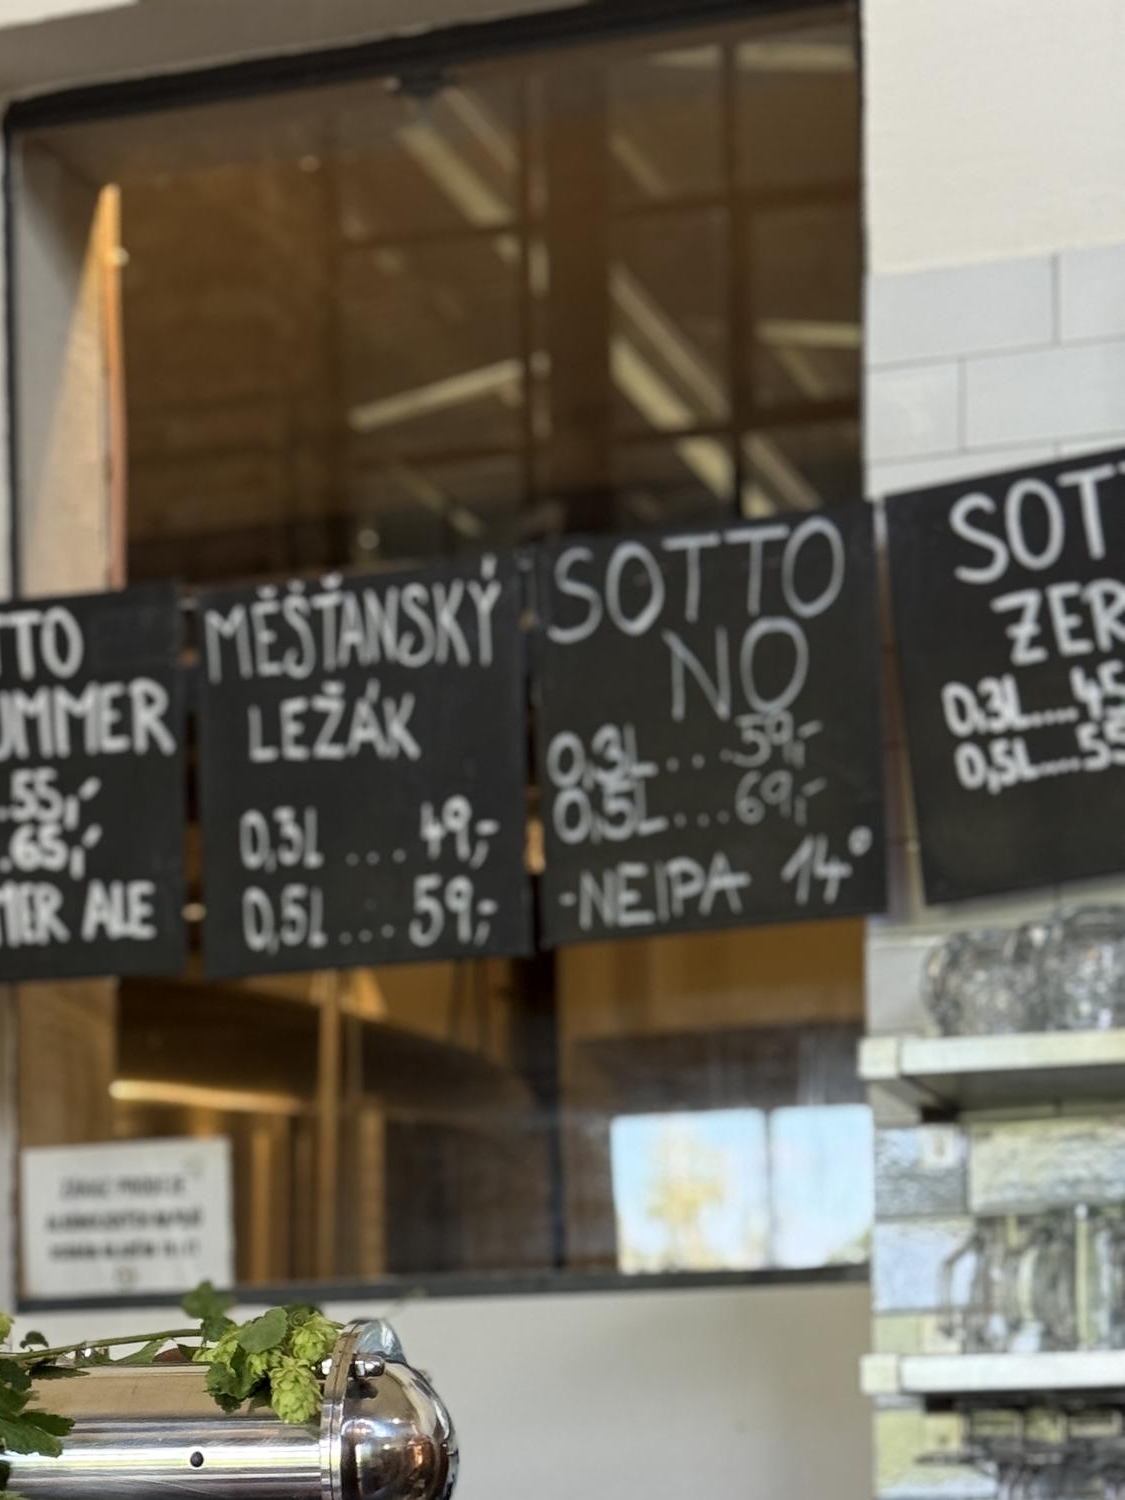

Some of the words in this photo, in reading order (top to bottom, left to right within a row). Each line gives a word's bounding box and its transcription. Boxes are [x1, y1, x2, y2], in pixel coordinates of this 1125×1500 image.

[949, 461, 1125, 584] SOT
[546, 515, 845, 644] SOTTO
[246, 677, 422, 763] LEŽÁK
[661, 615, 809, 722] NO
[80, 877, 158, 942] ALE
